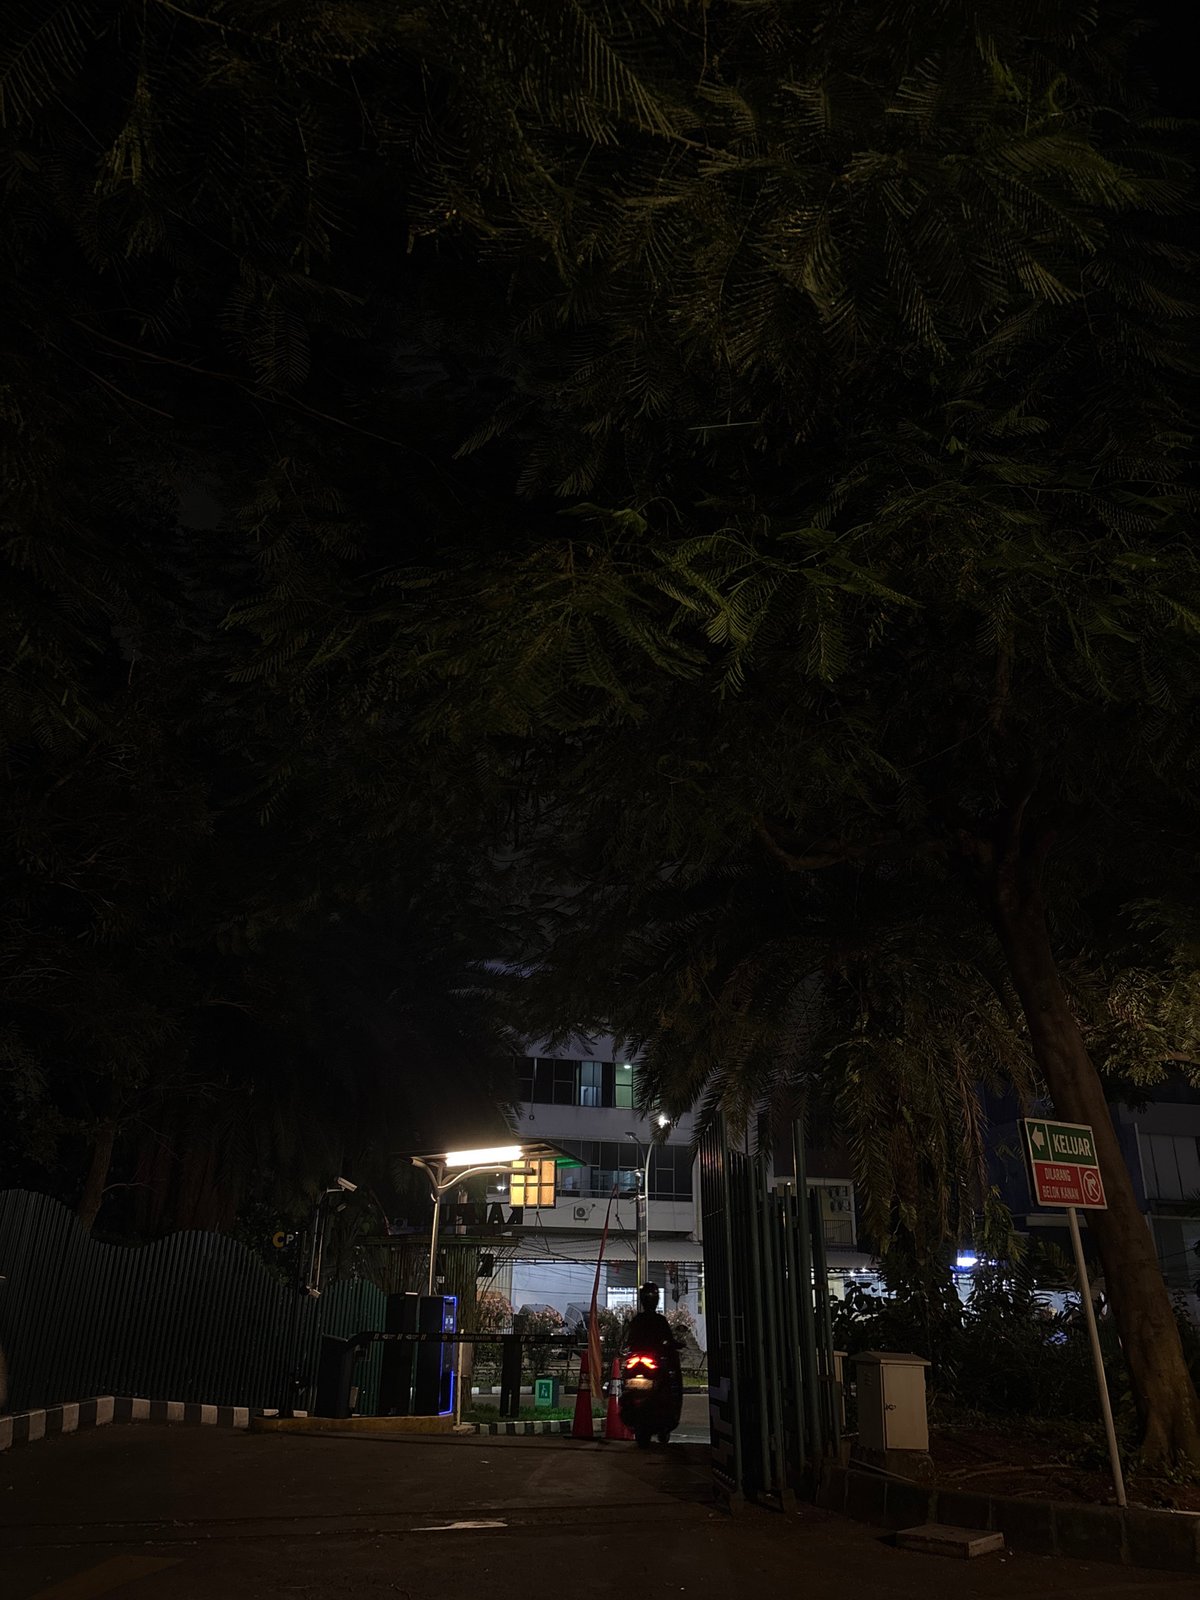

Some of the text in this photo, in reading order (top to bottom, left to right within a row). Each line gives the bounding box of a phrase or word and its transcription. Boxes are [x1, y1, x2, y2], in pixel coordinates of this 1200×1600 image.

[1053, 1134, 1092, 1157] KELUAR
[1044, 1168, 1071, 1182] DILARANG
[1041, 1185, 1080, 1201] BELOK KANAN
